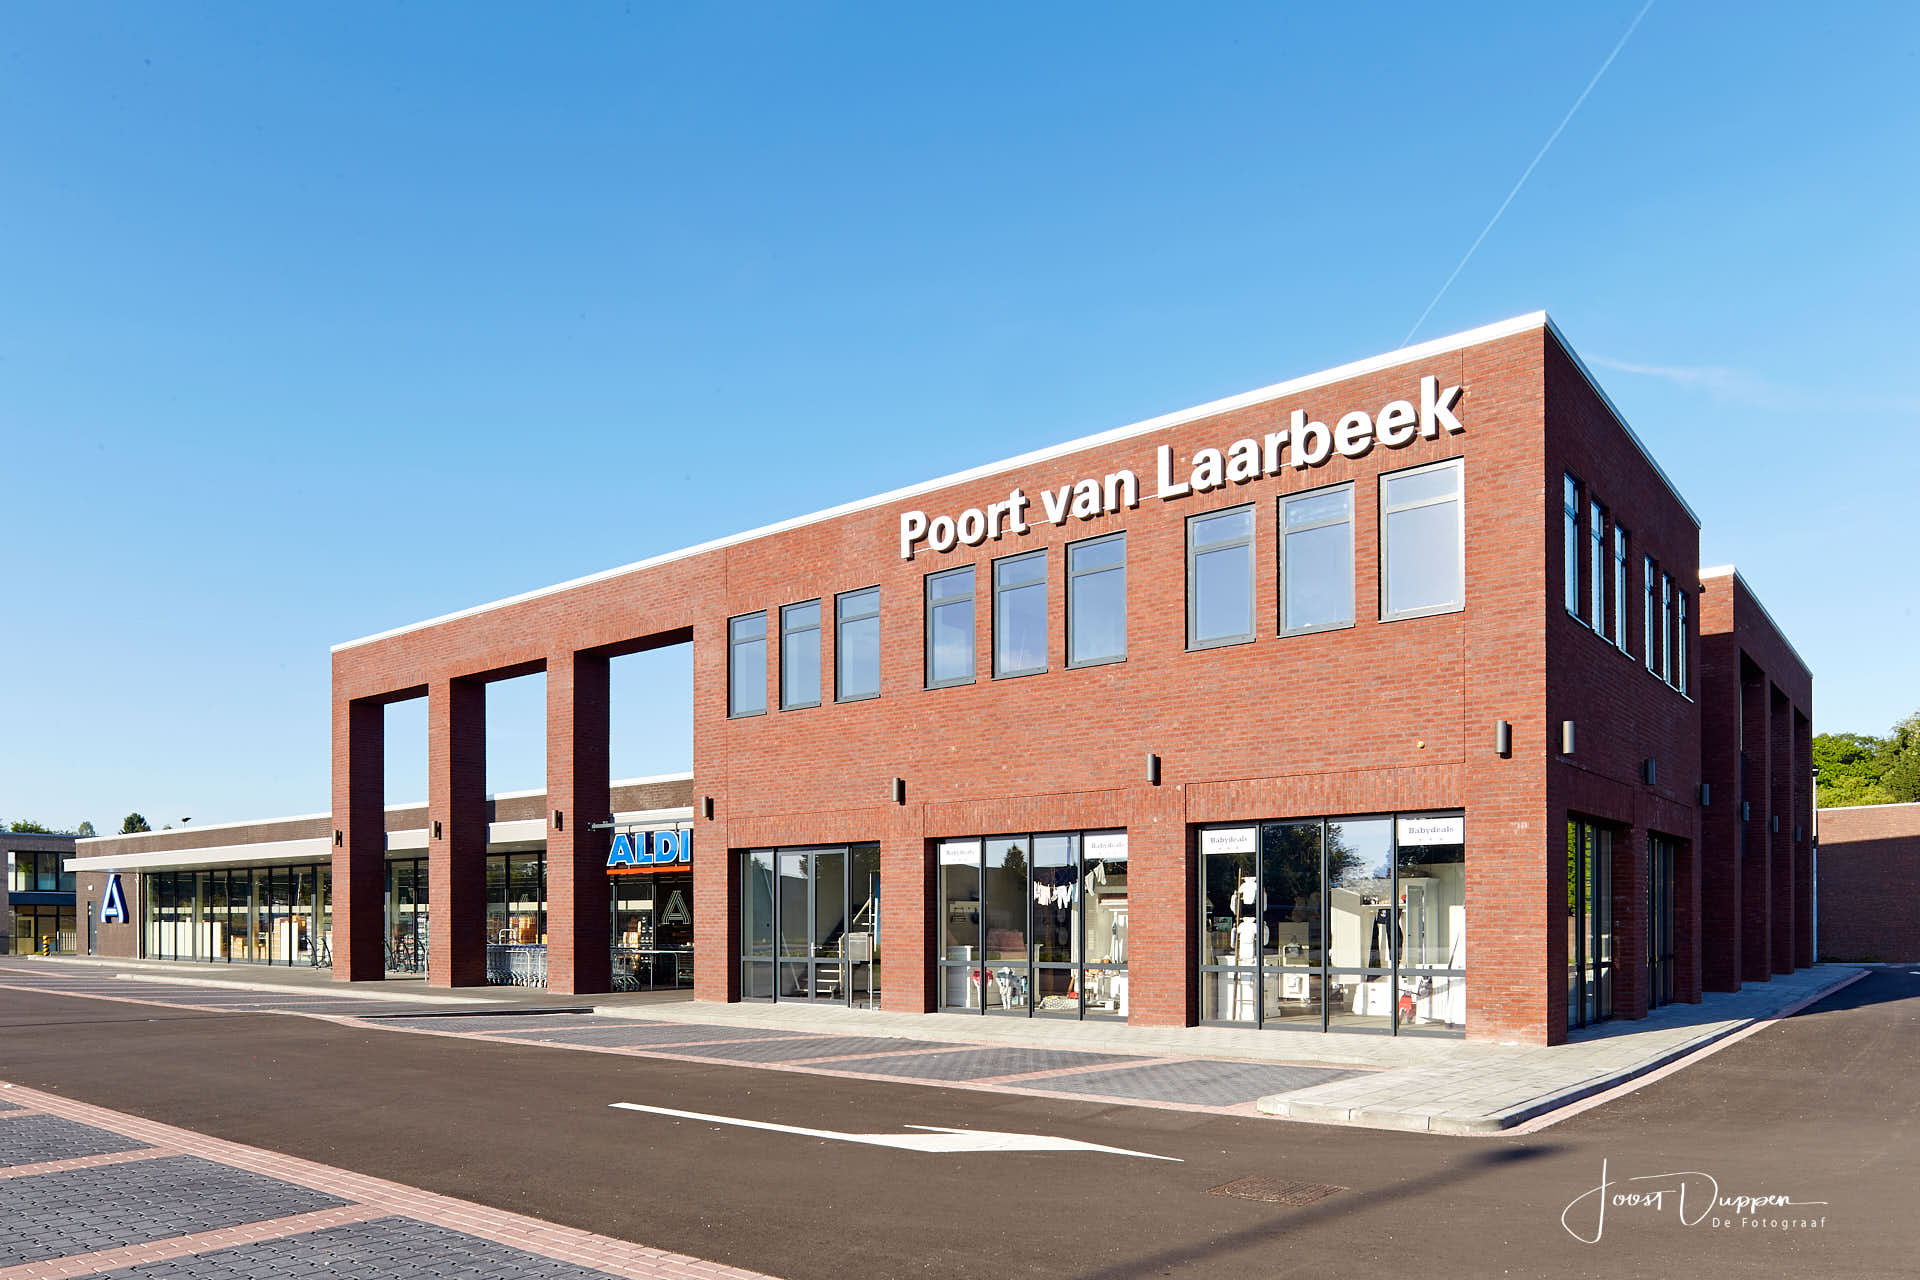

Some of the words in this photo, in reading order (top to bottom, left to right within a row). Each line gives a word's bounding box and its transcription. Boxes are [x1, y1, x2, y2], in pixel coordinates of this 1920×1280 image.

[900, 488, 1030, 559] Poort
[1041, 467, 1139, 525] van
[1156, 375, 1464, 501] Laarbeek
[606, 828, 693, 867] ALDI
[1408, 826, 1455, 834] Babydeals
[100, 873, 129, 924] A
[661, 890, 691, 925] A
